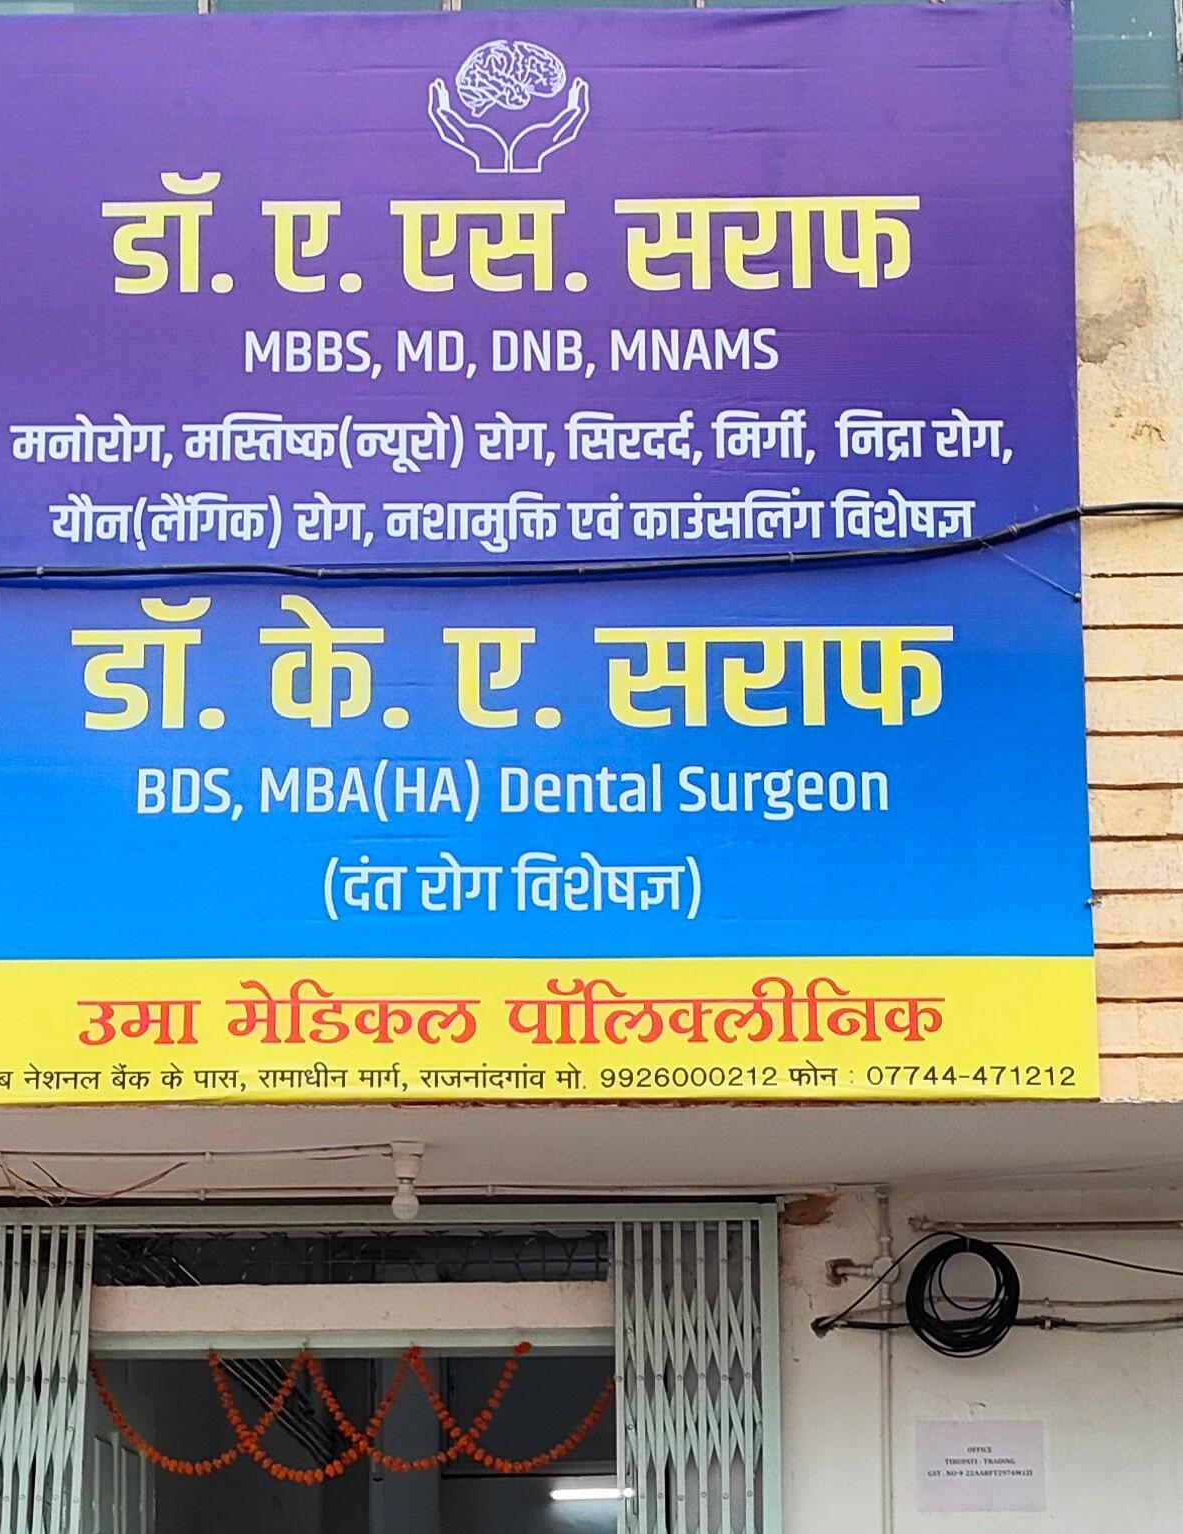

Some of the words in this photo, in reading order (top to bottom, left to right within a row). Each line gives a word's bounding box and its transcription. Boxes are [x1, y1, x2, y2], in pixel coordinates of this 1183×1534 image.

[102, 172, 233, 294] डॉ.
[262, 201, 361, 292] ए.
[390, 200, 587, 292] एस.
[615, 196, 919, 290] सराफ
[246, 331, 381, 379] MBBS,
[398, 331, 476, 378] MD,
[493, 330, 594, 378] DNB,
[612, 329, 778, 370] MNAMS
[10, 414, 173, 468] मनोरोग,
[182, 412, 463, 473] मस्तिष्क(न्यूरो)
[475, 412, 555, 466] रोग,
[564, 411, 702, 465] सिरदर्द,
[711, 409, 815, 464] मिर्गी,
[835, 409, 925, 460] निद्रा
[932, 409, 1012, 464] रोग,
[49, 493, 281, 551] यौन(लैंगिक)
[293, 492, 373, 547] रोग,
[383, 491, 560, 552] नशामुक्ति
[567, 493, 623, 540] एवं
[630, 488, 824, 539] काउंसलिंग
[831, 489, 975, 538] विशेषज्ञ
[72, 598, 224, 730] डॉ.
[260, 595, 409, 728] के.
[443, 628, 561, 728] ए.
[594, 626, 953, 727] सराफ
[138, 768, 242, 820] BDS,
[261, 763, 479, 821] MBA(HA)
[501, 764, 660, 812] Dental
[679, 766, 887, 820] Surgeon
[325, 856, 407, 919] (दंत
[417, 852, 502, 910] रोग
[512, 853, 700, 918] विशेषज्ञ)
[78, 1000, 201, 1046] उमा
[225, 979, 480, 1044] मेडिकल
[505, 976, 944, 1045] पॉलिक्लीनिक
[24, 1064, 101, 1089] नेशनल
[112, 1064, 150, 1089] बैंक
[161, 1063, 183, 1089] के
[194, 1071, 245, 1091] पास,
[259, 1062, 348, 1087] रामाधीन
[359, 1063, 407, 1091] मार्ग,
[420, 1064, 545, 1088] राजनांदगांव
[556, 1063, 588, 1088] मो.
[601, 1067, 777, 1087] 9926000212
[789, 1062, 837, 1085] फोन
[867, 1067, 1075, 1085] 07744-471212
